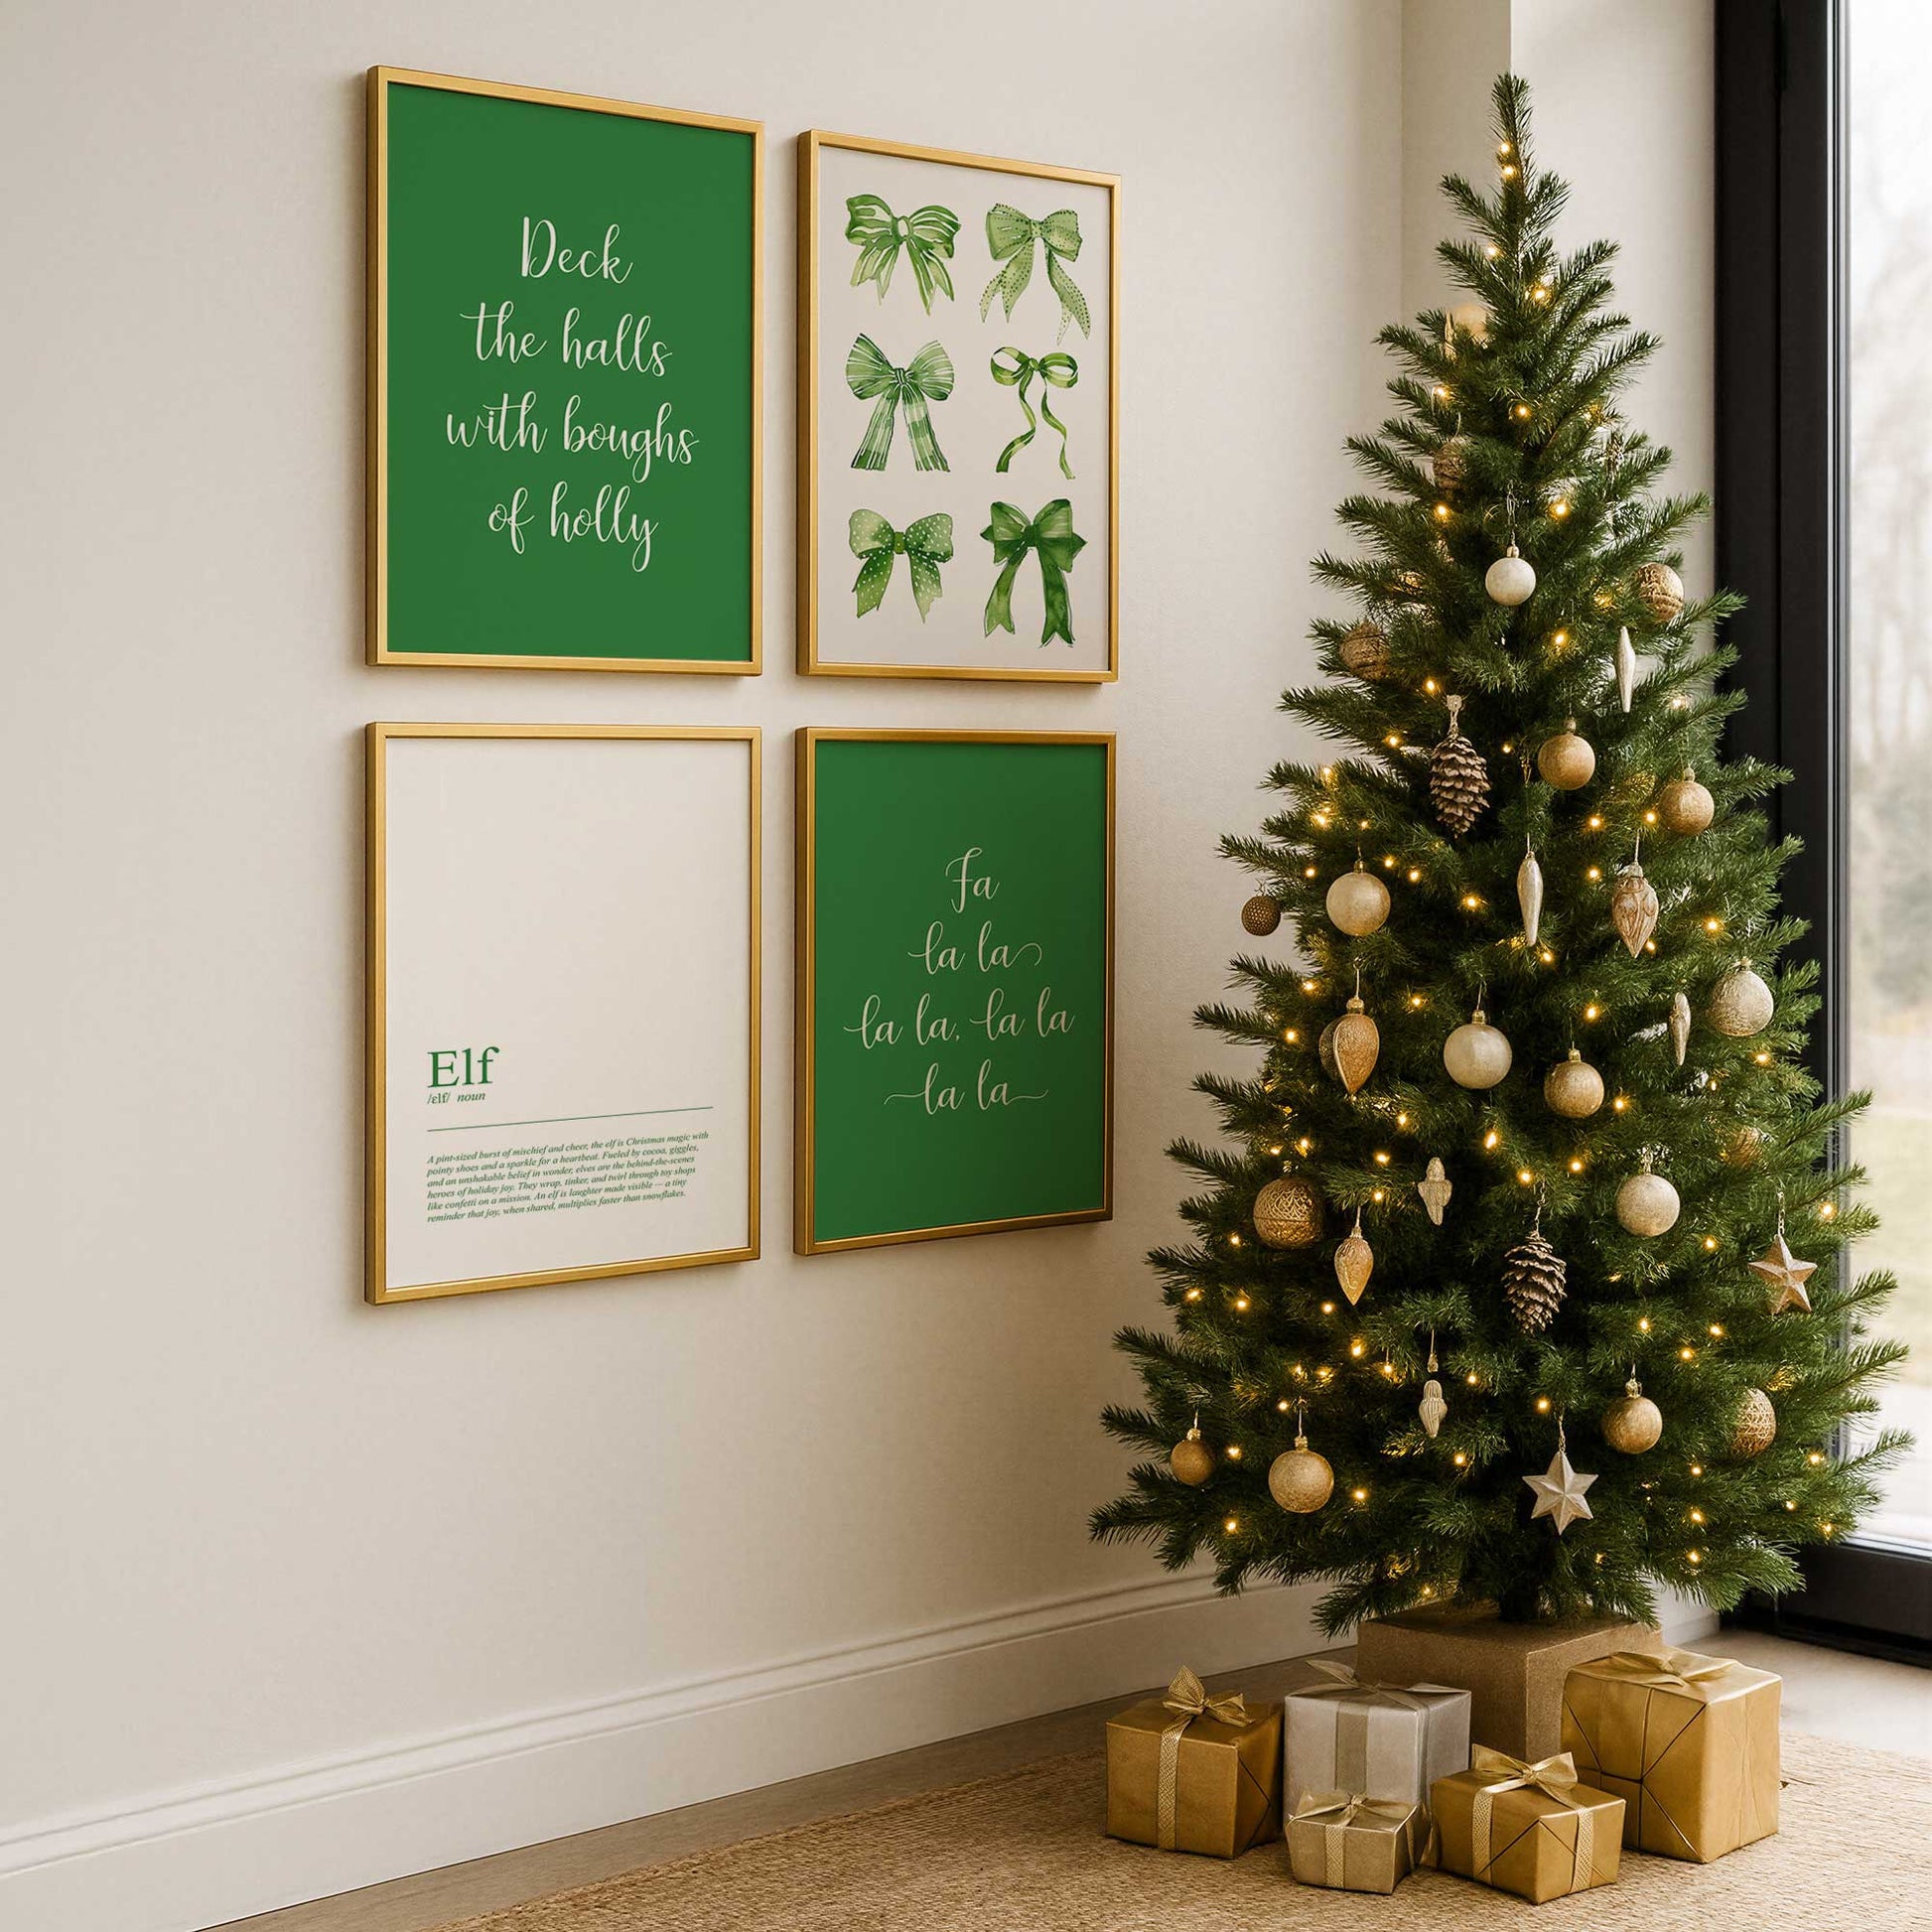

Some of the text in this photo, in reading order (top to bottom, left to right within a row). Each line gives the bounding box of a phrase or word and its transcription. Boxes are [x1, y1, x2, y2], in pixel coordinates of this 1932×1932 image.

[521, 215, 633, 284] Deck
[460, 300, 673, 377] the halls
[446, 390, 700, 483] with boughs
[487, 481, 659, 573] of holly
[945, 847, 1000, 913] Fa
[907, 920, 1042, 975] la la
[843, 986, 1076, 1049] la la, la la
[427, 1046, 500, 1088] Elf
[884, 1058, 1049, 1115] la la
[457, 1092, 486, 1103] noun
[426, 1167, 455, 1177] pointy
[456, 1165, 479, 1173] shoes
[481, 1162, 497, 1171] and
[505, 1159, 537, 1171] sparkle
[537, 1157, 552, 1167] for
[560, 1154, 600, 1164] heartbeat.
[602, 1151, 629, 1161] Fueled
[631, 1149, 641, 1159] by
[642, 1147, 667, 1156] cocoa,
[669, 1144, 699, 1156] giggles,
[427, 1177, 444, 1187] and
[458, 1173, 506, 1184] unshakable
[507, 1170, 531, 1180] belief
[543, 1168, 573, 1176] wonder,
[576, 1165, 596, 1173] elves
[626, 1156, 695, 1169] behind-the-scenes
[435, 1152, 478, 1165] pint-sized
[479, 1151, 500, 1160] burst
[501, 1148, 512, 1159] of
[511, 1145, 548, 1156] mischief
[548, 1144, 565, 1153] and
[565, 1143, 588, 1152] cheer,
[605, 1139, 618, 1149] elf
[625, 1137, 665, 1146] Christmas
[666, 1134, 691, 1143] magic
[692, 1131, 709, 1140] with
[427, 1190, 455, 1199] heroes
[457, 1187, 468, 1199] of
[468, 1184, 500, 1196] holiday
[499, 1184, 515, 1194] joy.
[518, 1181, 538, 1192] They
[565, 1176, 589, 1185] tinker,
[591, 1173, 607, 1183] and
[608, 1172, 627, 1181] twirl
[628, 1169, 659, 1180] through
[674, 1166, 696, 1175] shops
[427, 1202, 444, 1211] like
[445, 1198, 478, 1211] confetti
[498, 1195, 532, 1204] mission.
[534, 1191, 546, 1200] An
[547, 1189, 559, 1200] elf
[569, 1186, 603, 1197] laughter
[604, 1182, 625, 1192] made
[627, 1181, 653, 1191] visible
[672, 1178, 687, 1187] tiny
[427, 1189, 686, 1223] reminder that joy, when shared, multiplies faster than snowflakes.
